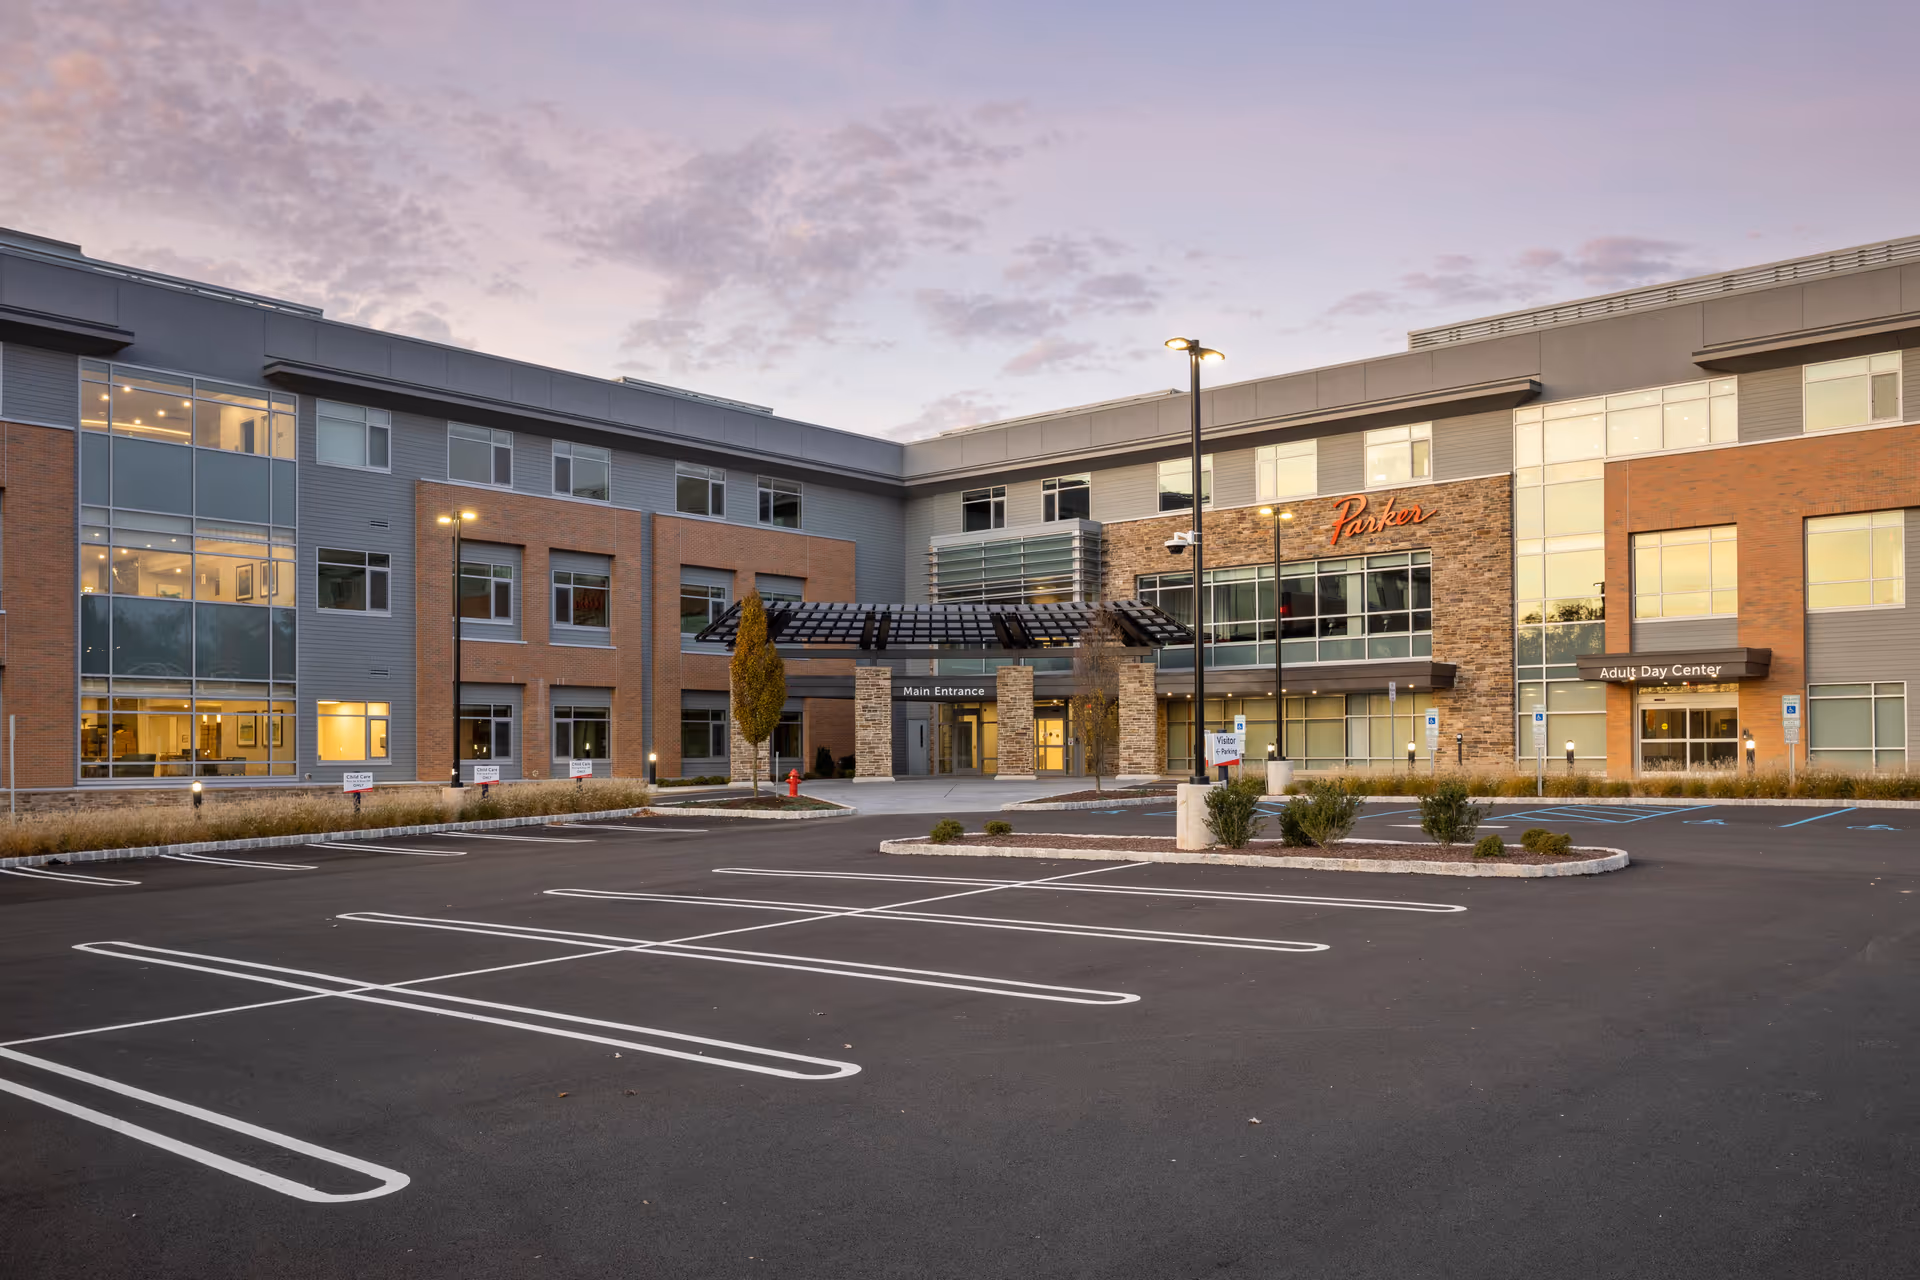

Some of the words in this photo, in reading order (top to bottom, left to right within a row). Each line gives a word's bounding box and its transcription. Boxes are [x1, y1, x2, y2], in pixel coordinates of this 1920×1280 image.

[1330, 494, 1437, 545] Parker
[1600, 666, 1636, 678] Adult
[1641, 666, 1667, 679] Day
[1672, 664, 1721, 676] Center
[903, 686, 930, 696] Main
[934, 686, 985, 696] Entrance
[1216, 735, 1236, 745] Visitor
[1221, 748, 1238, 756] Parking
